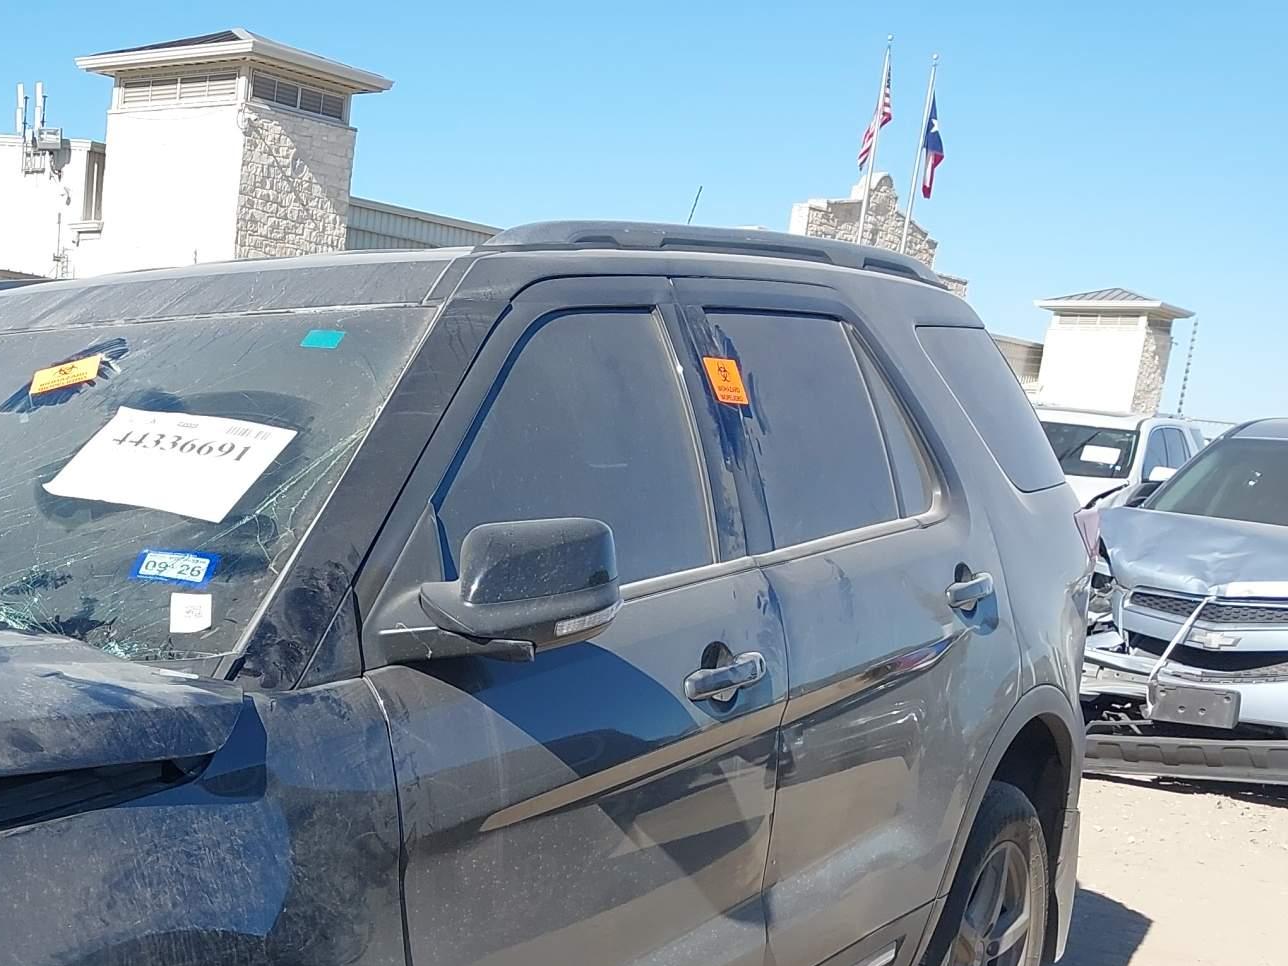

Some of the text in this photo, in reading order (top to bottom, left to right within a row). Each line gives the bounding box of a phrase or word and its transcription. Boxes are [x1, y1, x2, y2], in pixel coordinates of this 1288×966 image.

[112, 430, 252, 462] 44336691
[144, 560, 202, 577] 09 26
